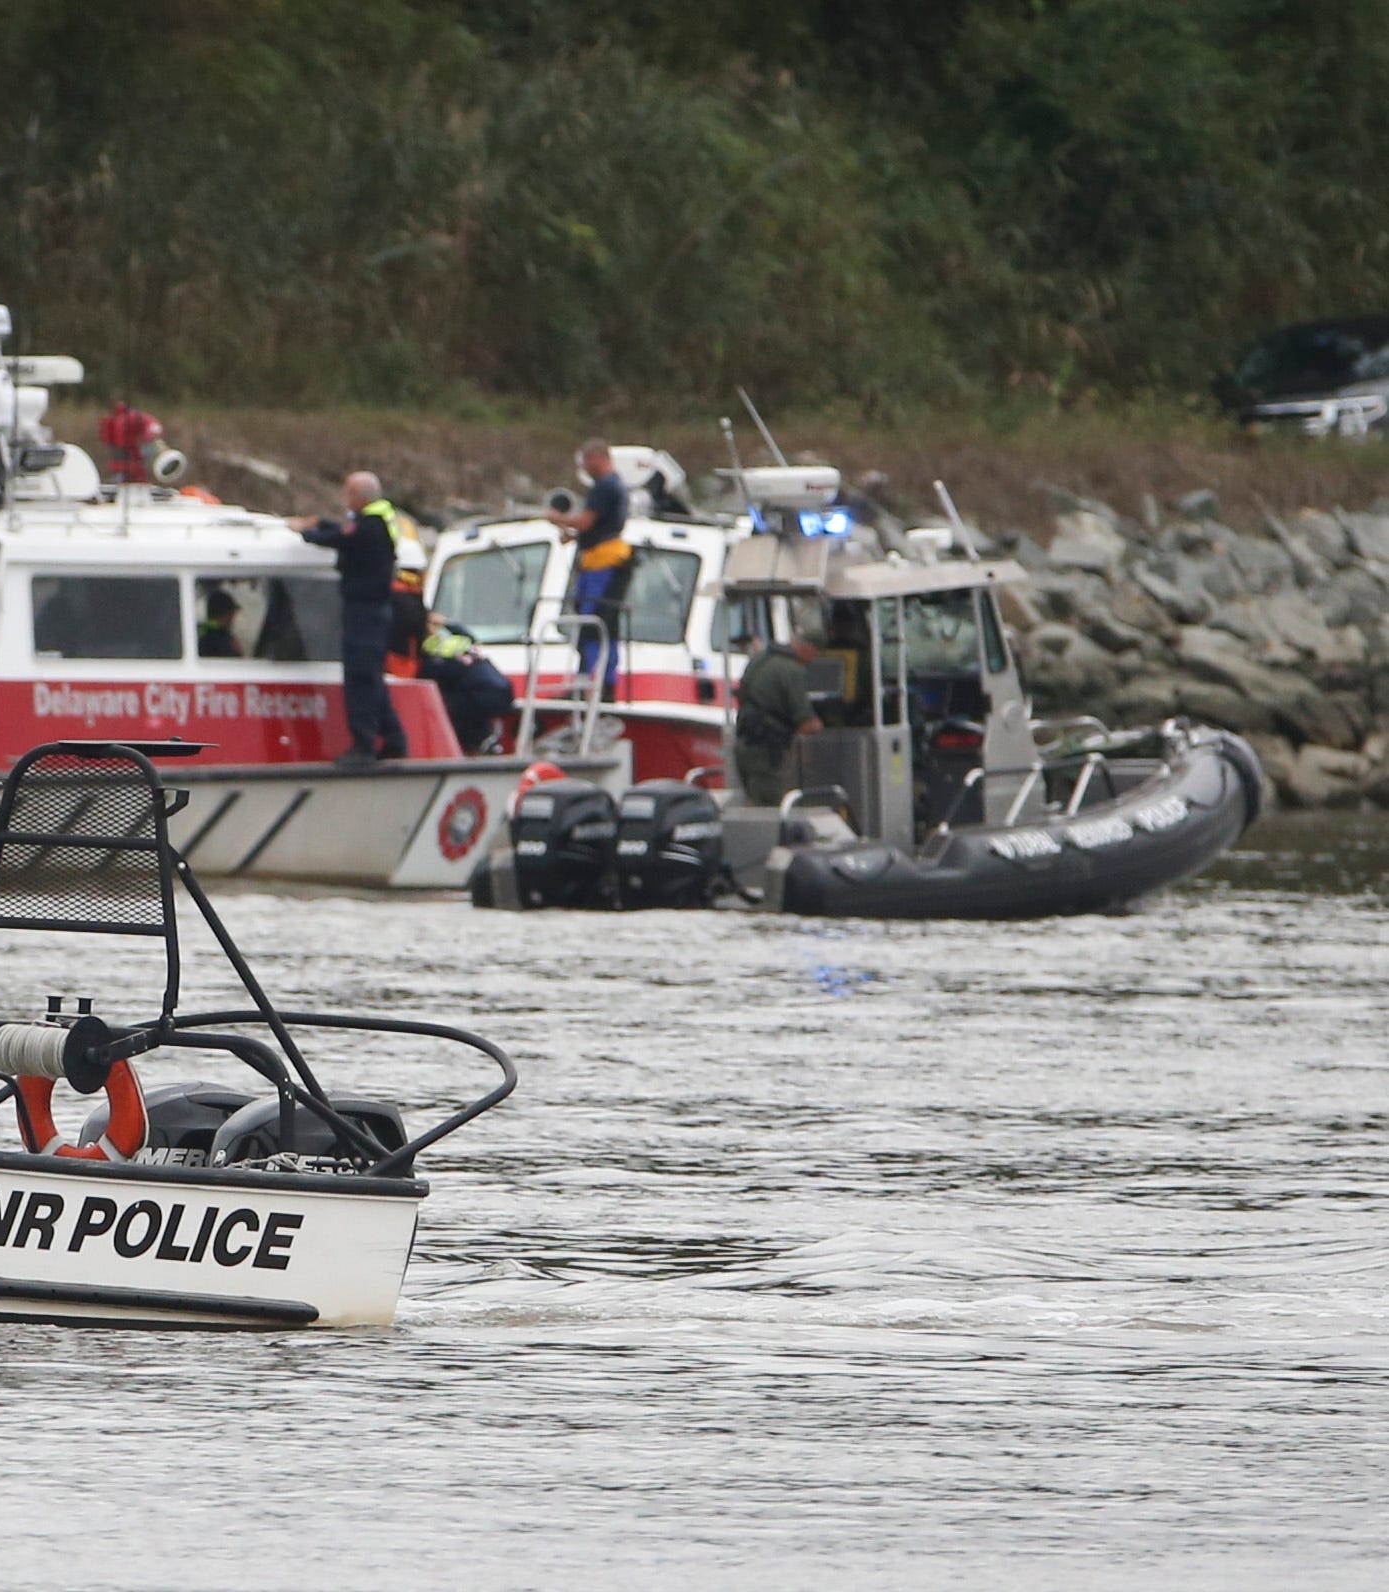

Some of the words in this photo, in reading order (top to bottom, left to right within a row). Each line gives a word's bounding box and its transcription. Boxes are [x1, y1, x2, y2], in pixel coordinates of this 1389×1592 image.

[33, 683, 139, 717] Delaware
[145, 683, 188, 726] City
[195, 684, 239, 718] Fire
[244, 684, 327, 719] Rescue
[135, 1147, 209, 1168] MER
[68, 1197, 304, 1271] POLICE
